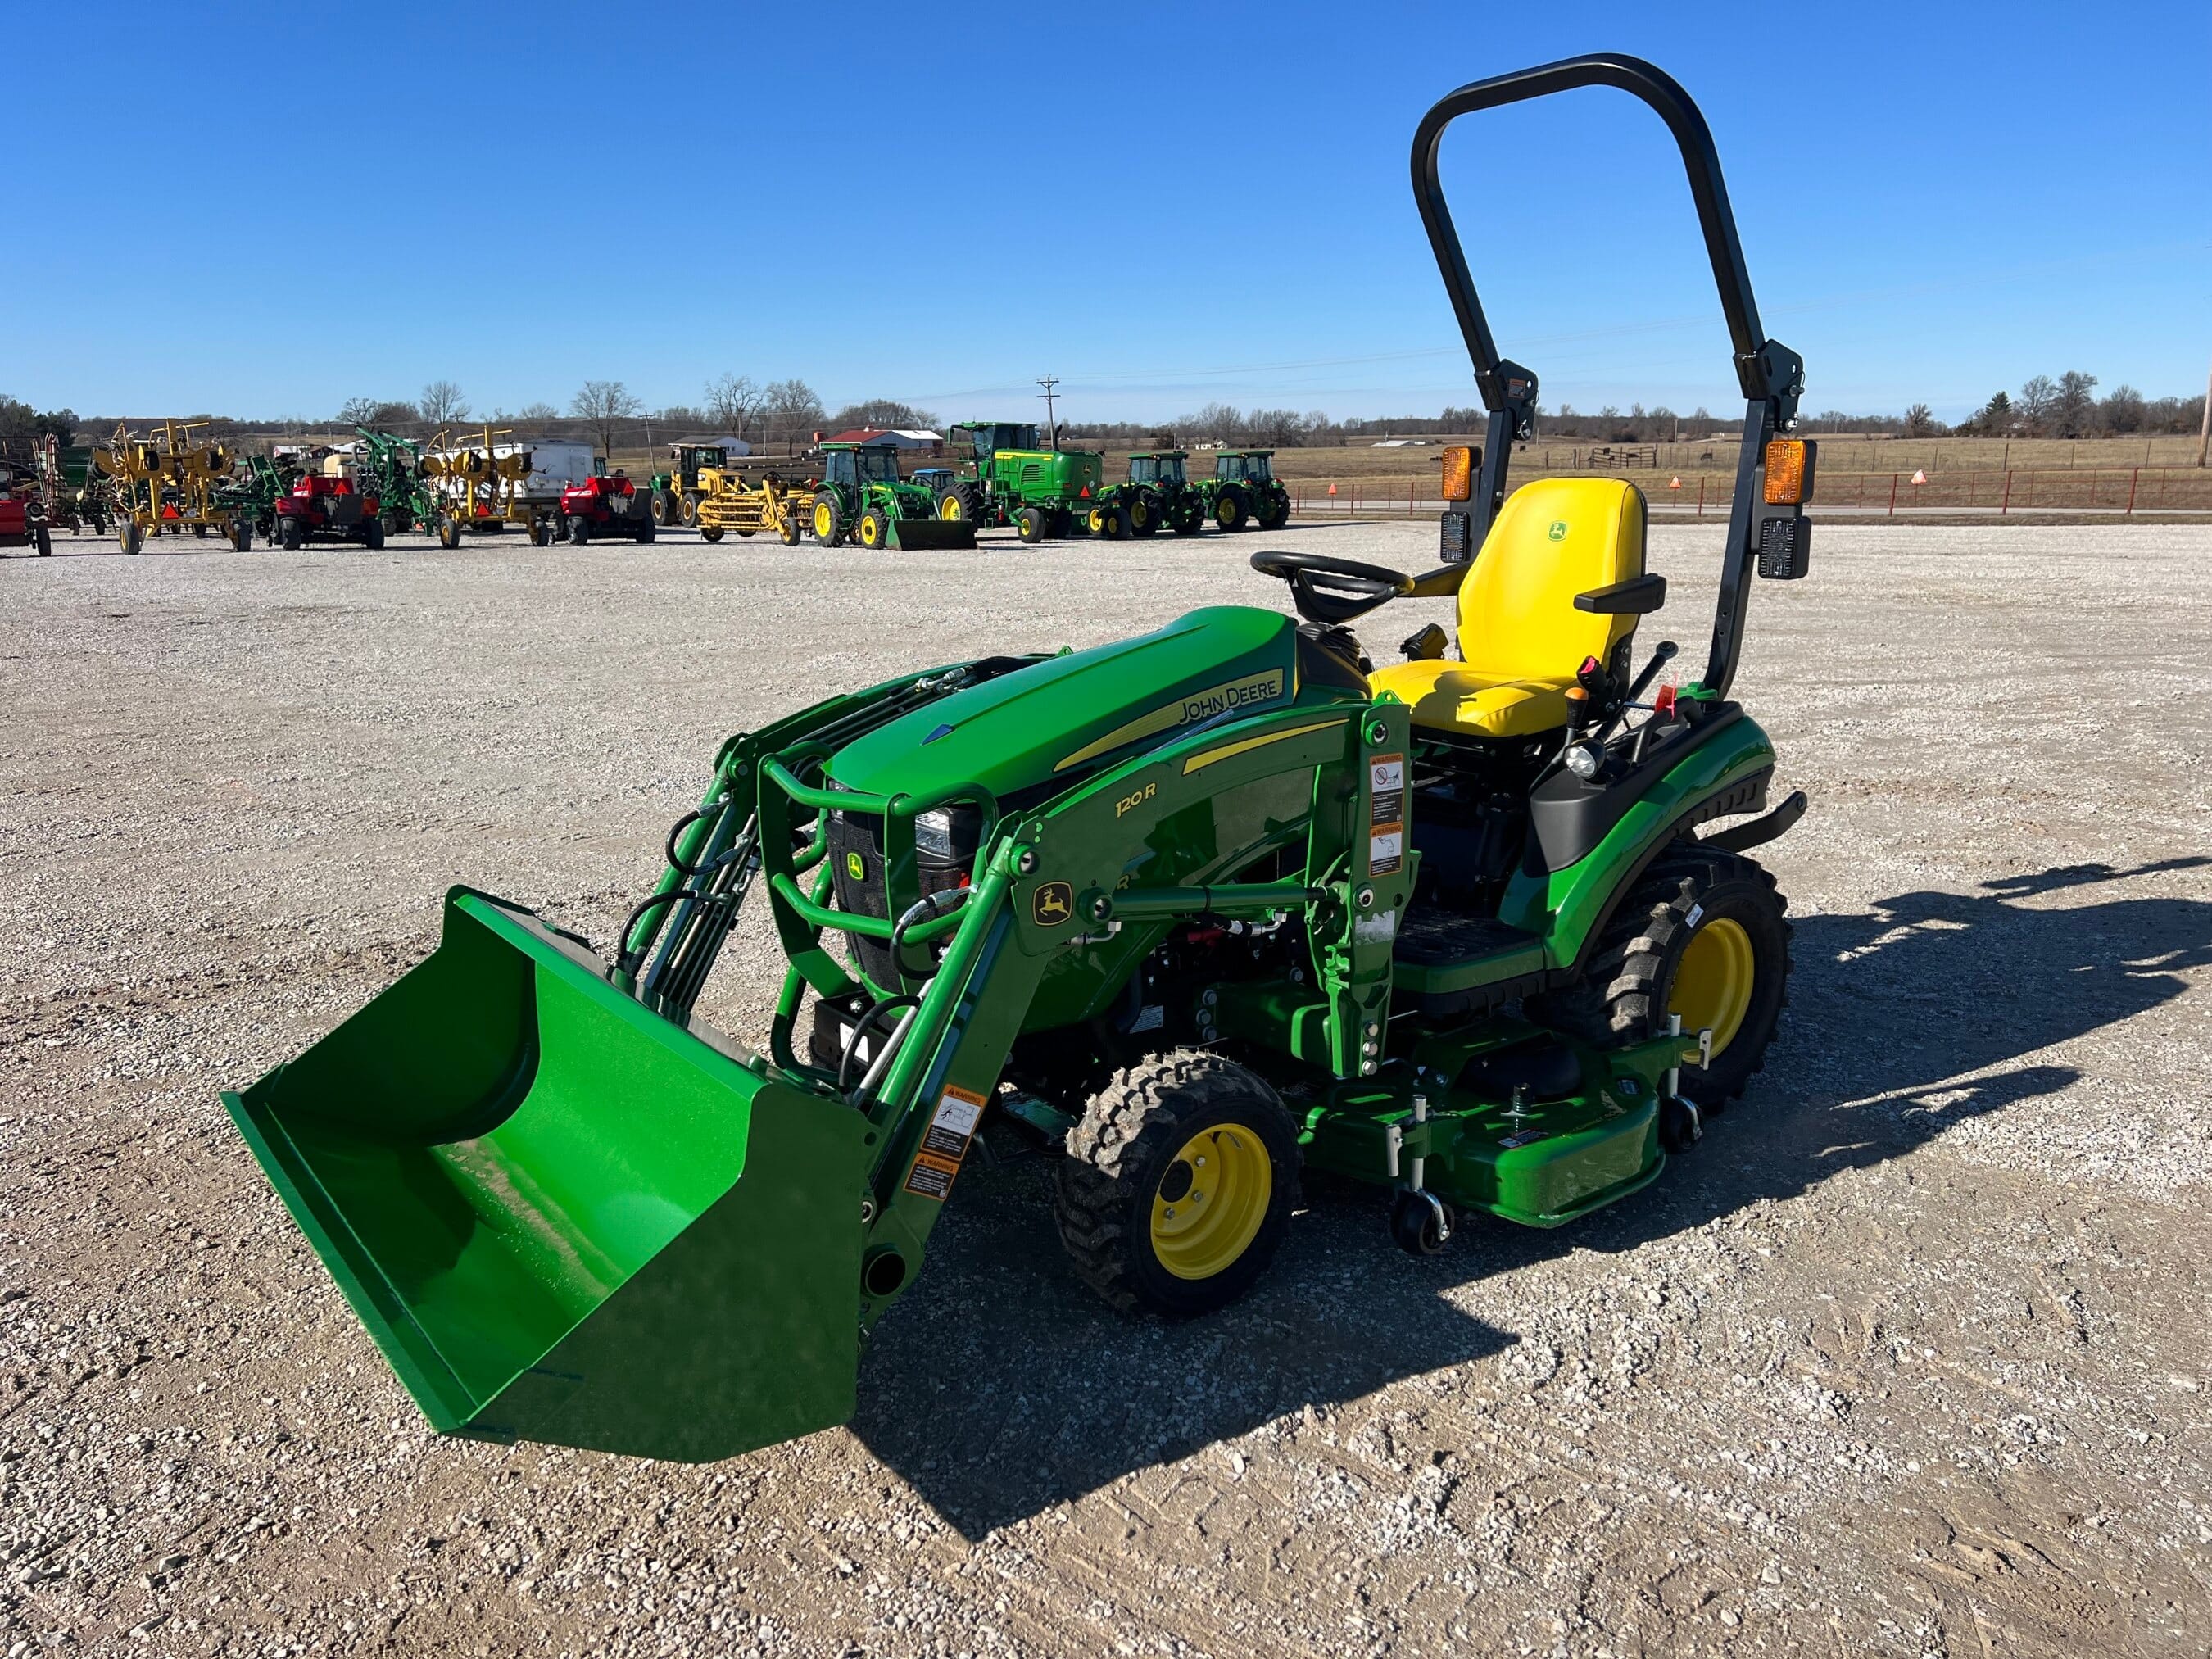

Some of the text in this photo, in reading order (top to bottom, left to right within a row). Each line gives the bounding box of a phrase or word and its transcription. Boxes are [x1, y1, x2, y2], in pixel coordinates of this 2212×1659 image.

[1180, 680, 1277, 723] JOHN DEERE
[1115, 782, 1156, 818] 120 R
[955, 1090, 981, 1104] WARNING
[927, 1158, 954, 1172] WARNING
